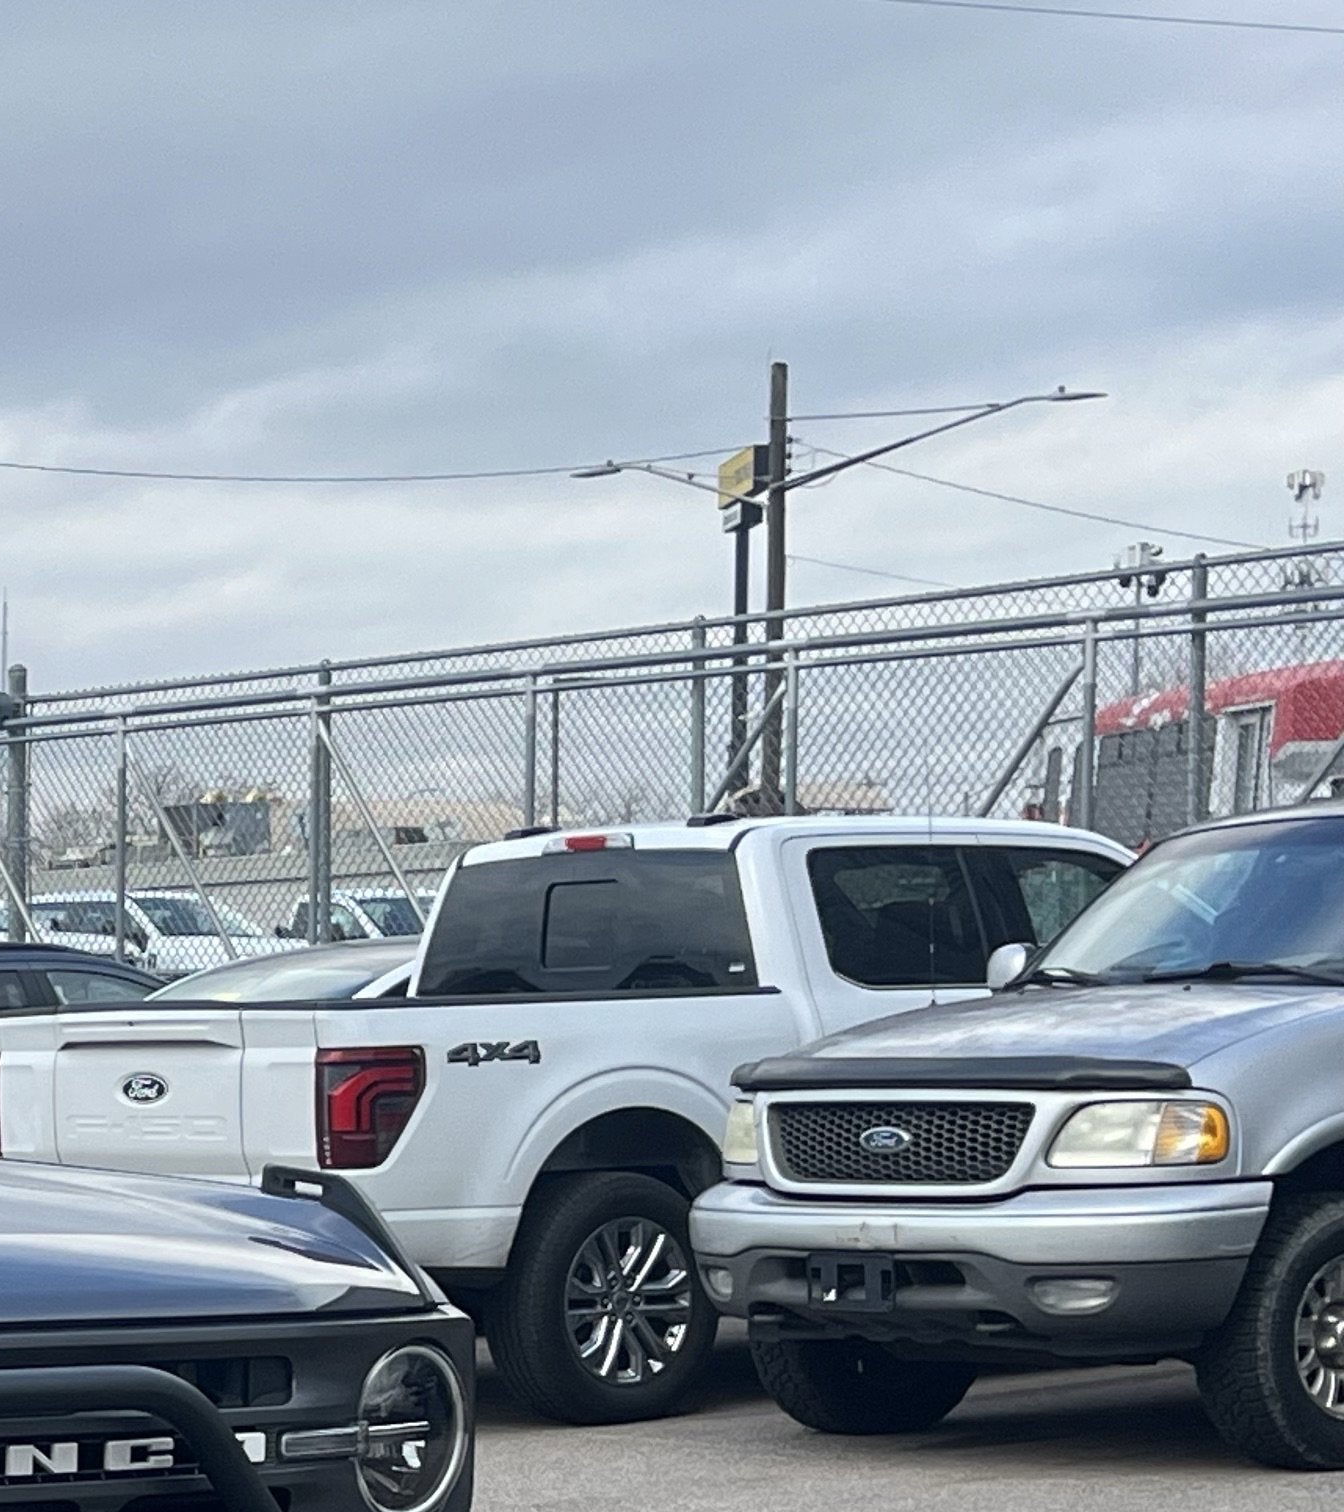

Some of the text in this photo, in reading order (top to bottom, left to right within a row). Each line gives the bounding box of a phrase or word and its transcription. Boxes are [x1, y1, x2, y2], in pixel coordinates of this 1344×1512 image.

[127, 1078, 161, 1099] Ford
[65, 1114, 229, 1141] F-150
[869, 1131, 899, 1148] Ford
